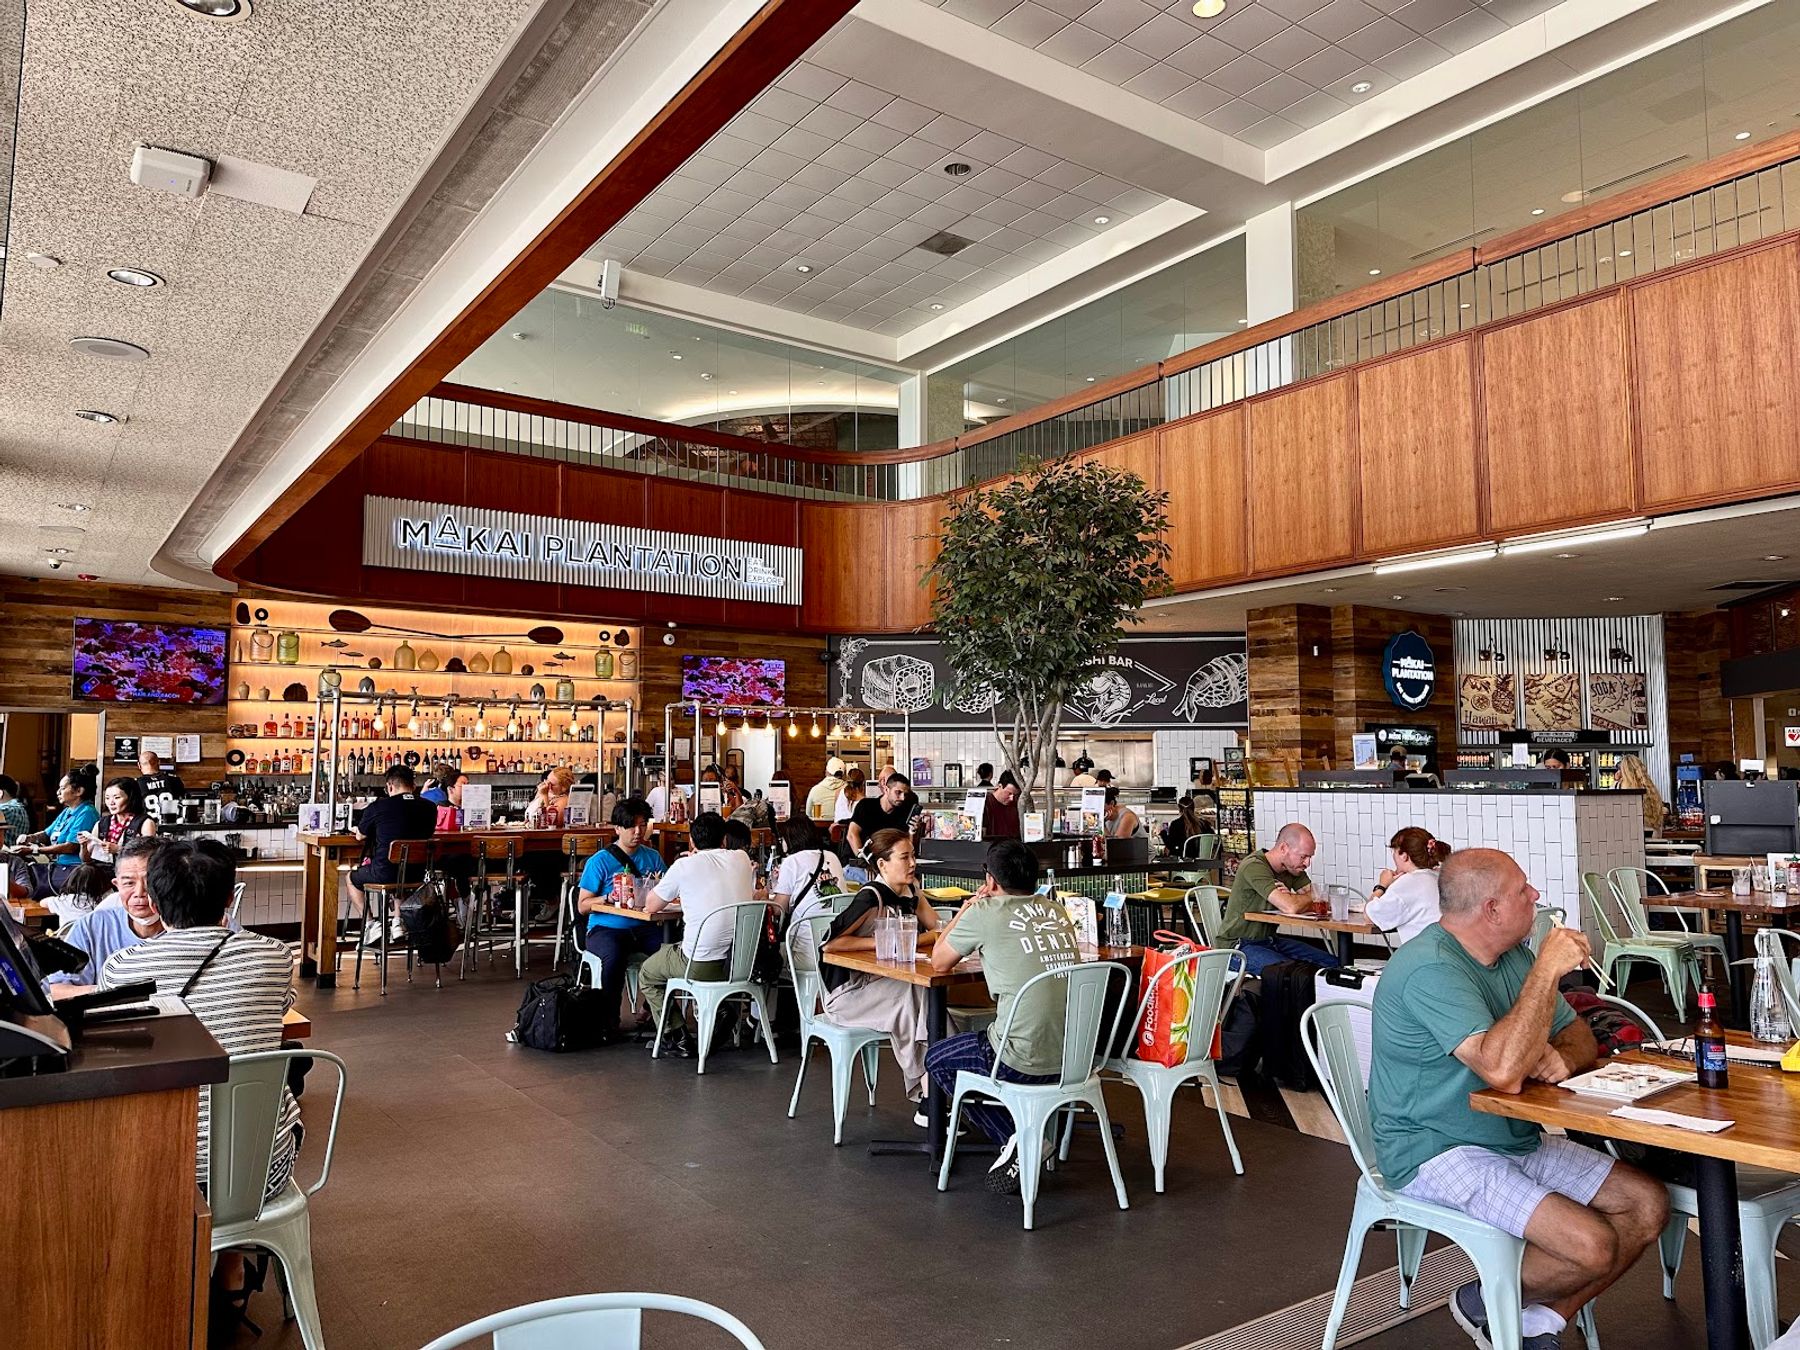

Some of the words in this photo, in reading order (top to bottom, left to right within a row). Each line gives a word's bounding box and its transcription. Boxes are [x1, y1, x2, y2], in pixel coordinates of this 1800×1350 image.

[543, 535, 743, 582] PLANTATION
[747, 574, 784, 585] EXPLORE
[1108, 655, 1133, 668] BAR
[1392, 667, 1434, 681] PLANTATION
[1591, 681, 1617, 698] SODA
[1464, 710, 1499, 726] Hawaii
[146, 780, 165, 790] WATT
[1009, 903, 1069, 931] DENHAM
[1040, 952, 1075, 963] AMSTERDAM
